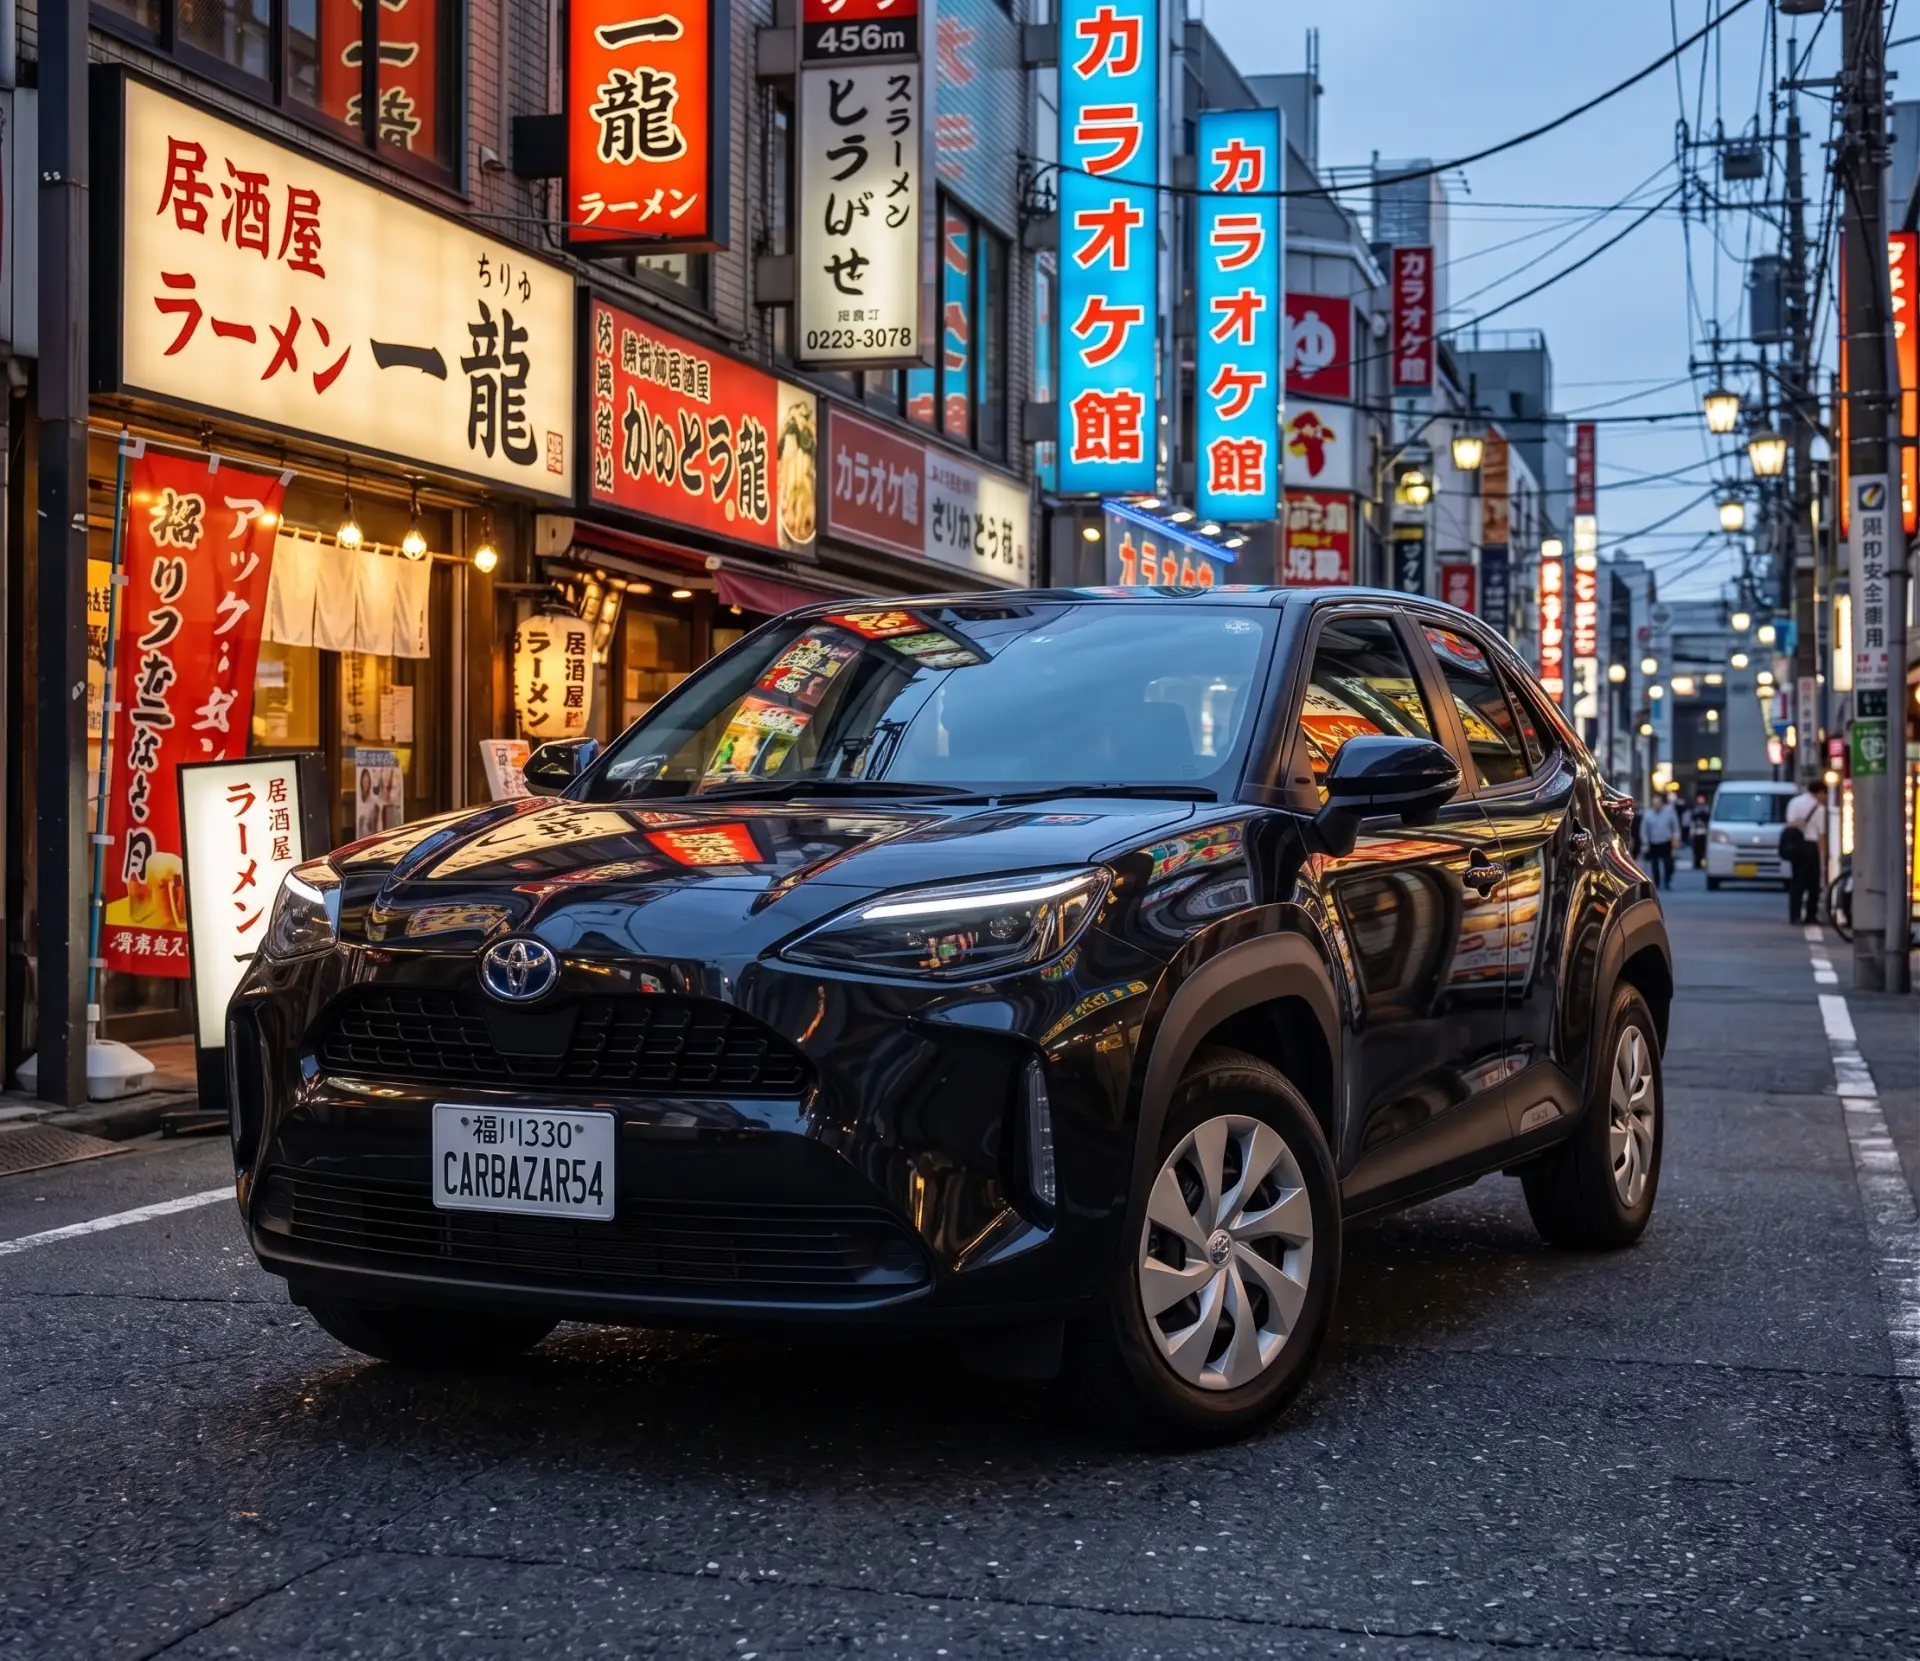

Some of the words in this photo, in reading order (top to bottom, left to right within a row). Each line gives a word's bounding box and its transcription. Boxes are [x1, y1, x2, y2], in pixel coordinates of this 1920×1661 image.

[817, 24, 905, 53] 456m
[590, 14, 687, 165] 一龍
[156, 135, 326, 279] 居酒屋
[578, 189, 698, 225] ラーメン
[1070, 8, 1144, 463] カラオケ館
[807, 327, 911, 350] 0223-3078
[1207, 138, 1267, 496] カラオケ館
[154, 271, 352, 395] ラーメン
[370, 300, 538, 466] 一龍
[527, 631, 551, 728] ラーメン
[563, 631, 586, 708] 居酒屋
[226, 782, 265, 934] ラーメン
[266, 777, 293, 862] 居酒屋
[443, 1151, 604, 1206] CARBAZAR54
